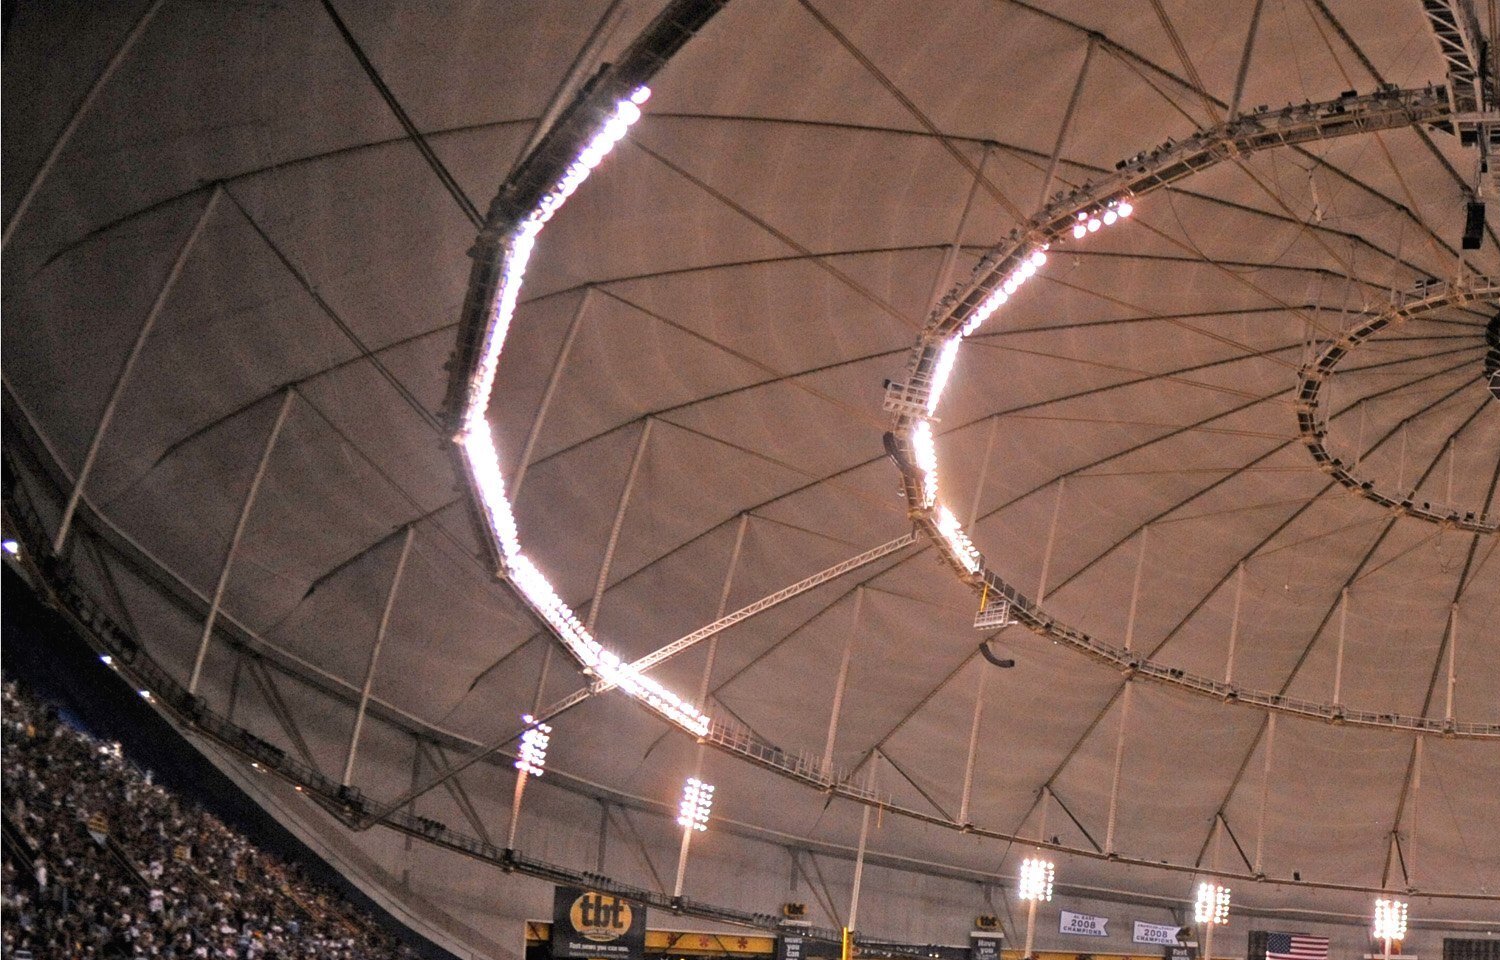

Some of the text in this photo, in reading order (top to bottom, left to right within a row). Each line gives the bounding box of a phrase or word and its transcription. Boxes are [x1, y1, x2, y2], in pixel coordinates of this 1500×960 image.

[580, 895, 624, 928] tbt
[1071, 918, 1096, 929] 2008
[1063, 926, 1102, 936] CHAMPIONS
[1143, 928, 1168, 939] 2008
[978, 939, 996, 948] Have
[1136, 935, 1173, 944] CHAMPIONS
[980, 947, 994, 956] you
